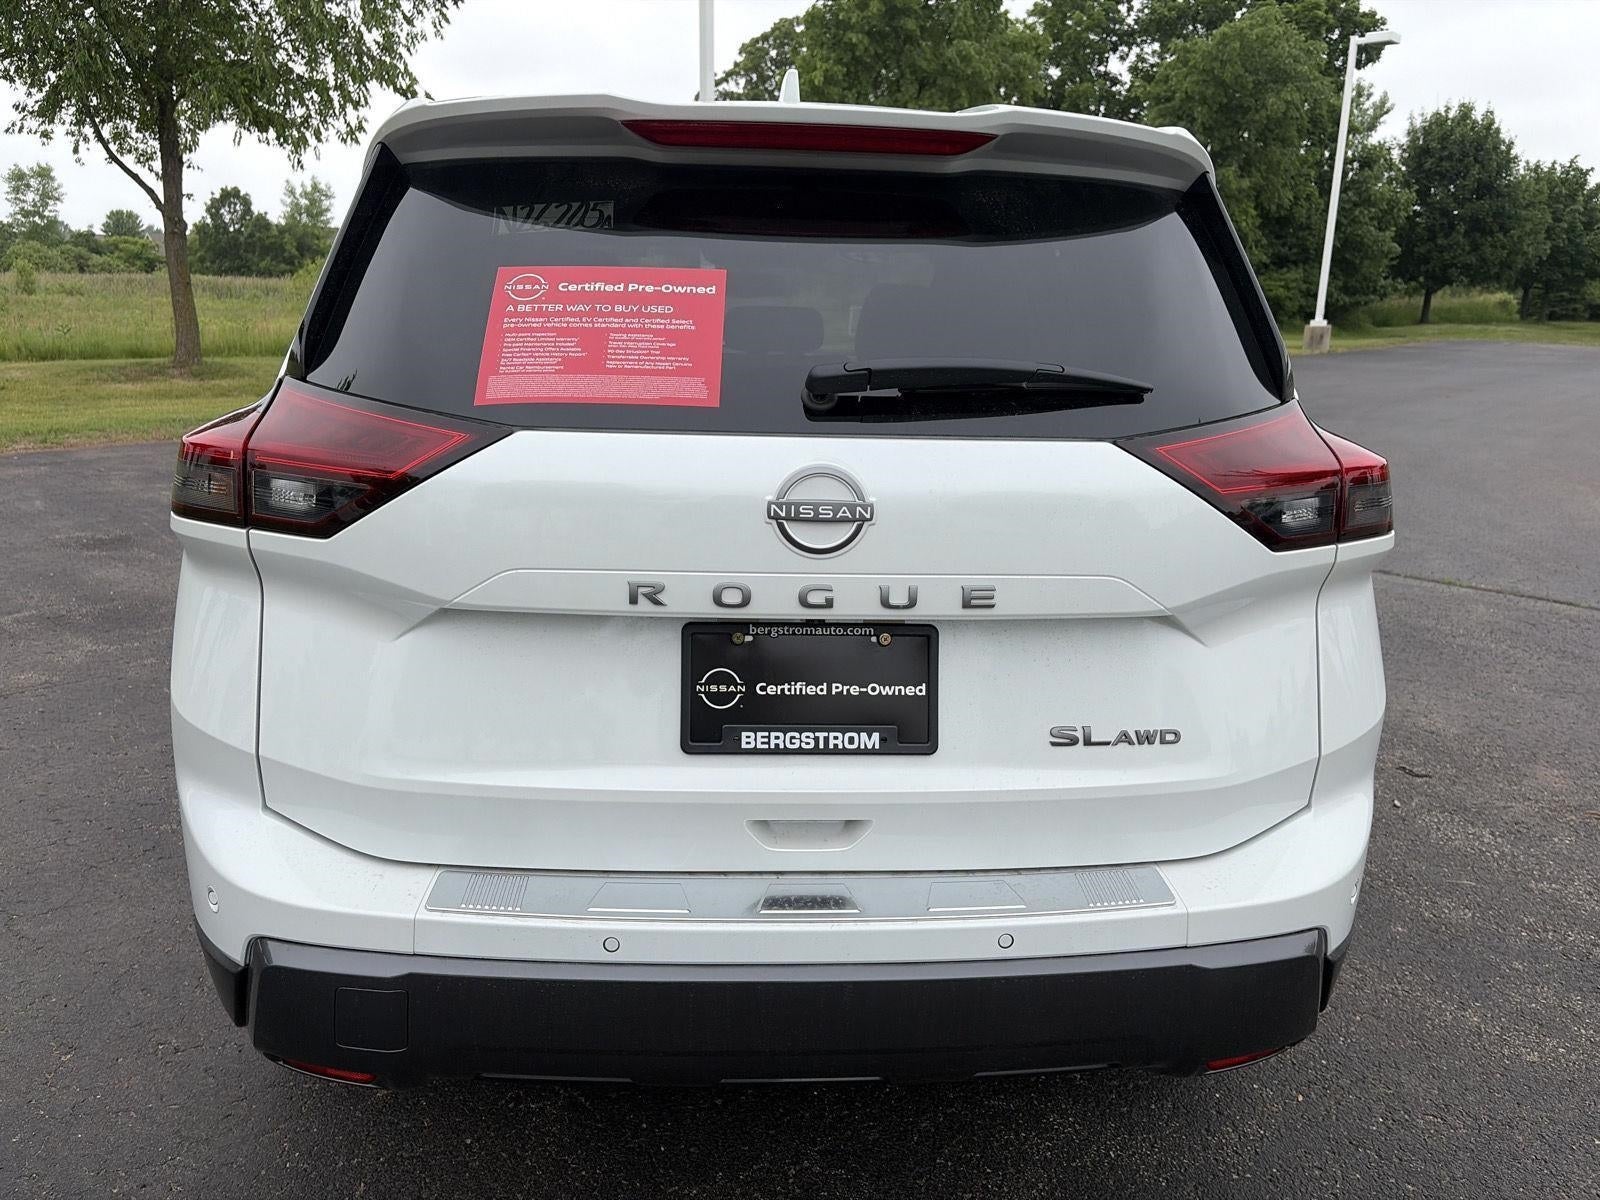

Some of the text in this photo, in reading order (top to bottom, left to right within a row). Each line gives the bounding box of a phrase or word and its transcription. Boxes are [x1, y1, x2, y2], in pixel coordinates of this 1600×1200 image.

[558, 282, 716, 294] Certified Pre-Owned
[505, 304, 674, 313] A BETTER WAY TO BUY USED
[770, 502, 872, 519] NISSAN
[627, 580, 997, 609] ROGUE
[749, 624, 875, 637] bergstromauto.com
[696, 684, 746, 693] NISSAN
[756, 682, 927, 696] Certified Pre-Owned
[741, 731, 880, 749] BERGSTROM
